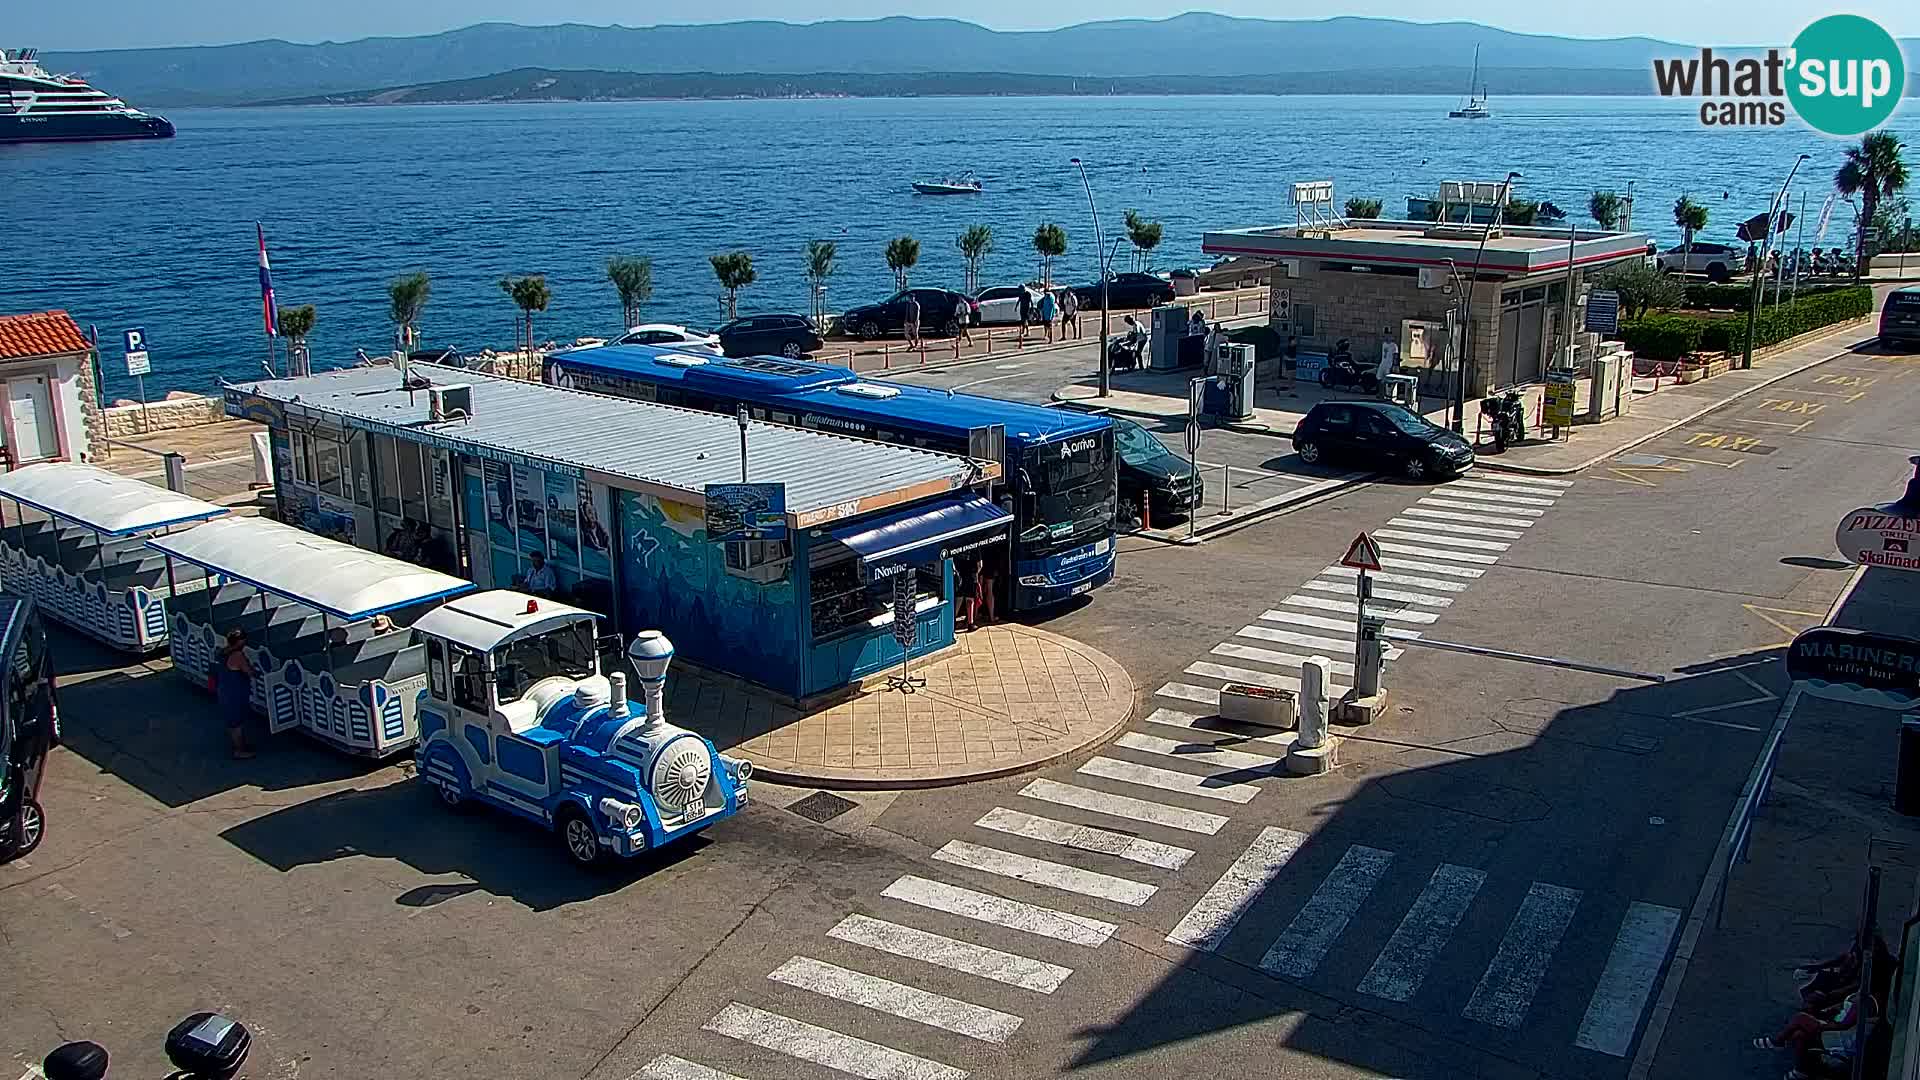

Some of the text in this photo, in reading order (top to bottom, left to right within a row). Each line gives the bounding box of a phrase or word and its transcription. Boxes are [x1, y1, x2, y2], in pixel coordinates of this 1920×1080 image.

[128, 332, 142, 350] P
[1813, 374, 1879, 387] TAXI
[1757, 398, 1827, 415] TAXI
[1071, 438, 1096, 453] arriva
[1684, 432, 1762, 451] TAXI
[477, 447, 492, 458] BUS
[493, 452, 525, 465] STATION
[527, 458, 552, 471] TICKET
[554, 463, 581, 477] OFFICE
[1880, 531, 1917, 541] GRILL
